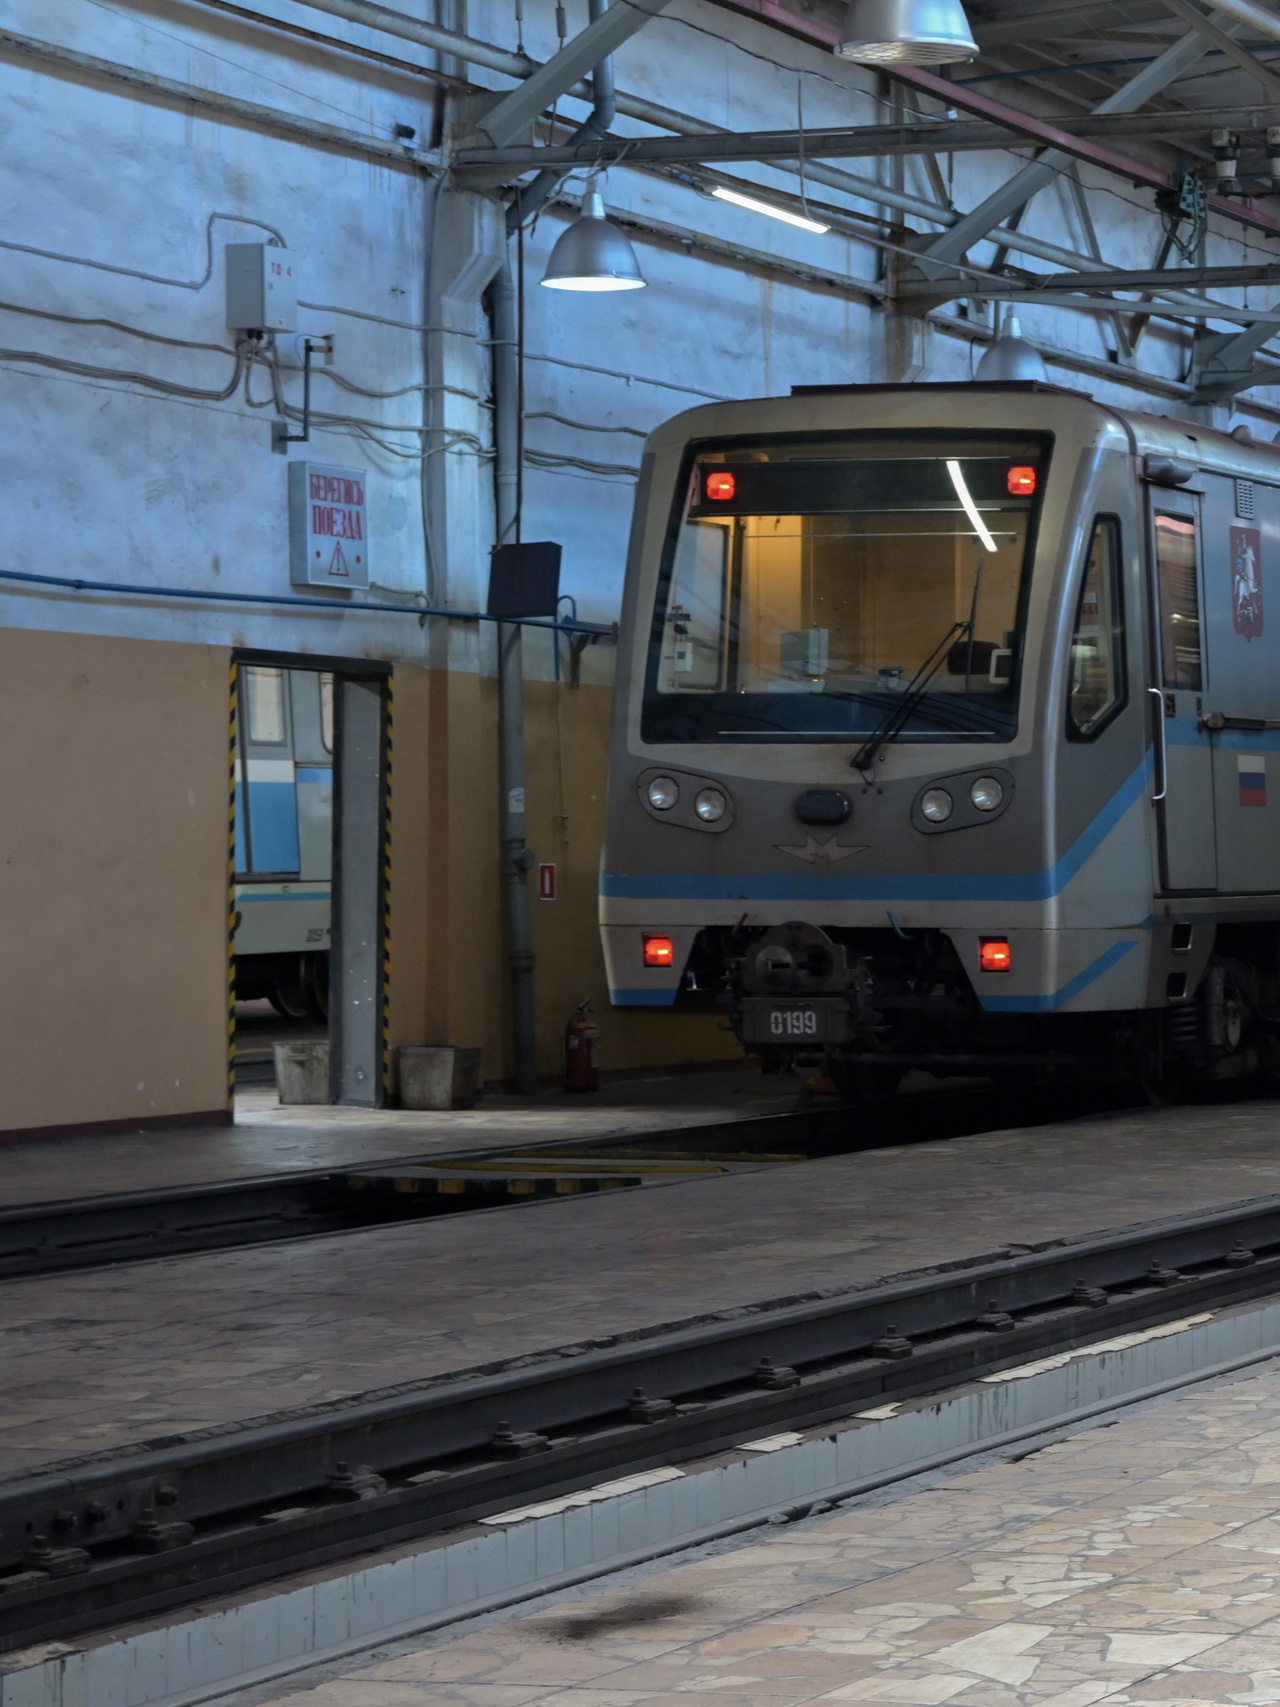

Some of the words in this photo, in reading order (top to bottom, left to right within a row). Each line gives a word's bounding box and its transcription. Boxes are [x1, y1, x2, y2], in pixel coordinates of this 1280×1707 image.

[310, 474, 363, 506] БЕРЕГИСЬ
[312, 505, 363, 540] ПОЕЗДА
[770, 1011, 817, 1035] 0199
